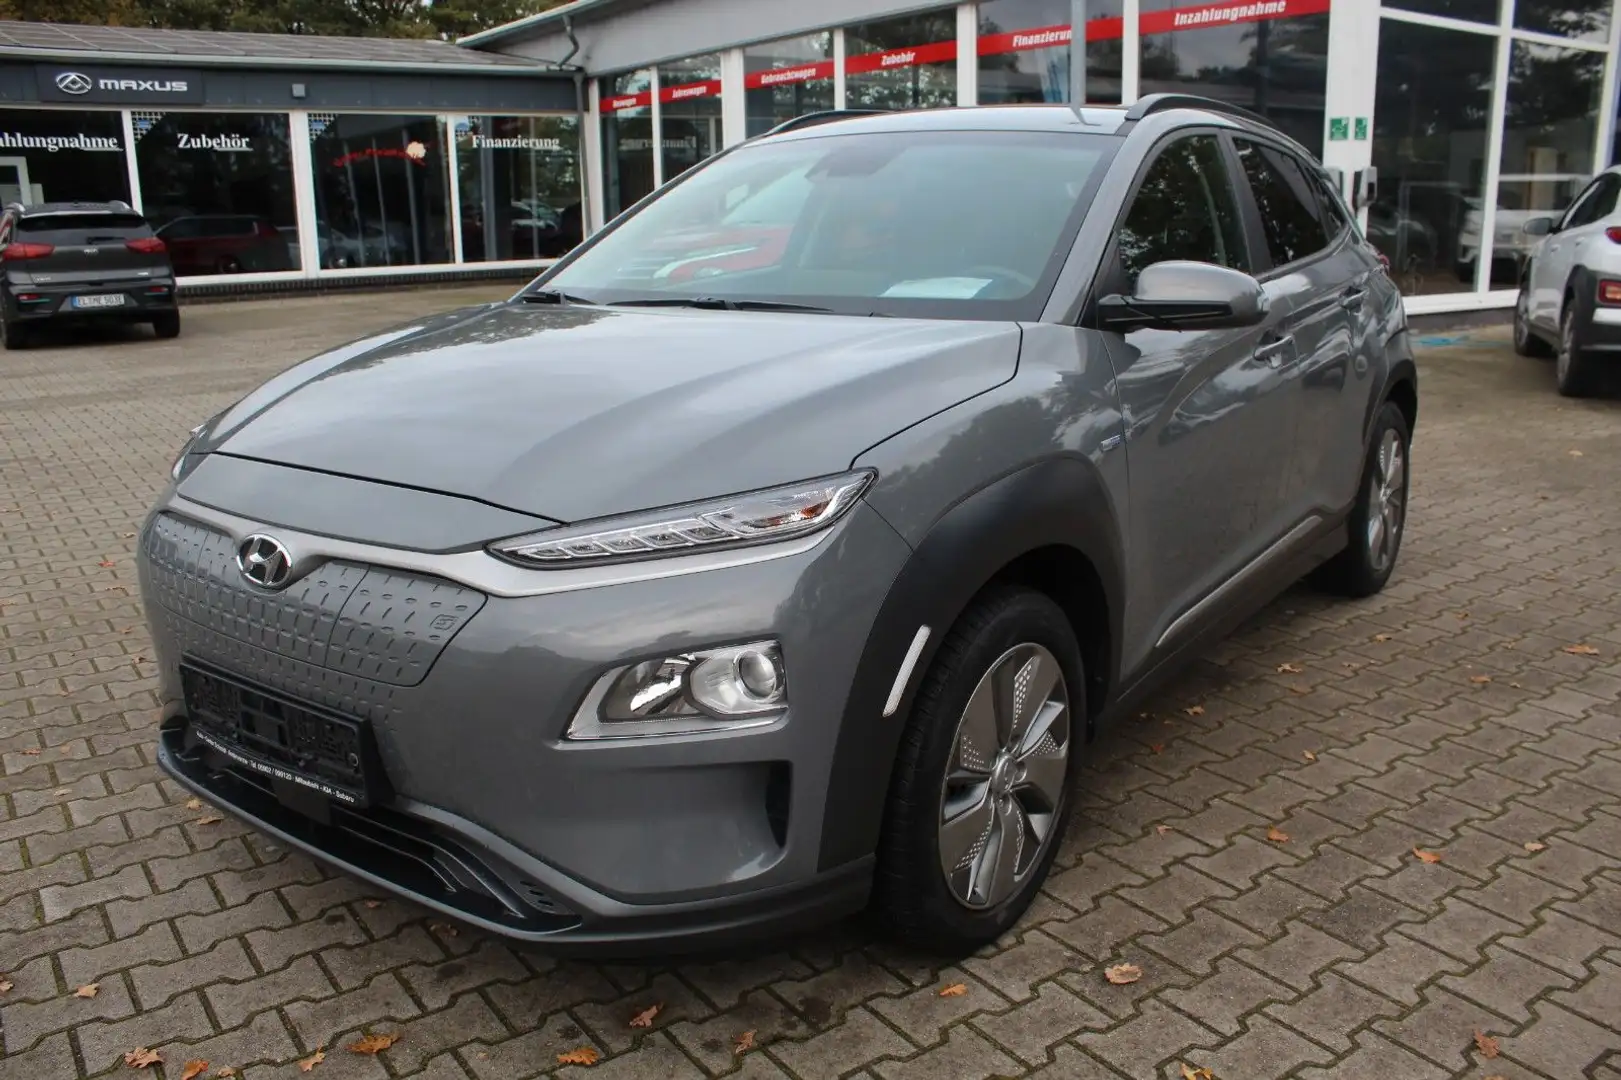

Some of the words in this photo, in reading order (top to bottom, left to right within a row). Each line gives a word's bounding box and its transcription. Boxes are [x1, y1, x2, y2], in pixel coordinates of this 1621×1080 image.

[1174, 1, 1287, 26] Inzahlungnahme
[1012, 30, 1072, 48] Finanzierun
[881, 51, 916, 66] Zubehör
[99, 78, 188, 92] MAXUS
[177, 132, 251, 149] Zubehör
[472, 134, 561, 151] Finanzierung
